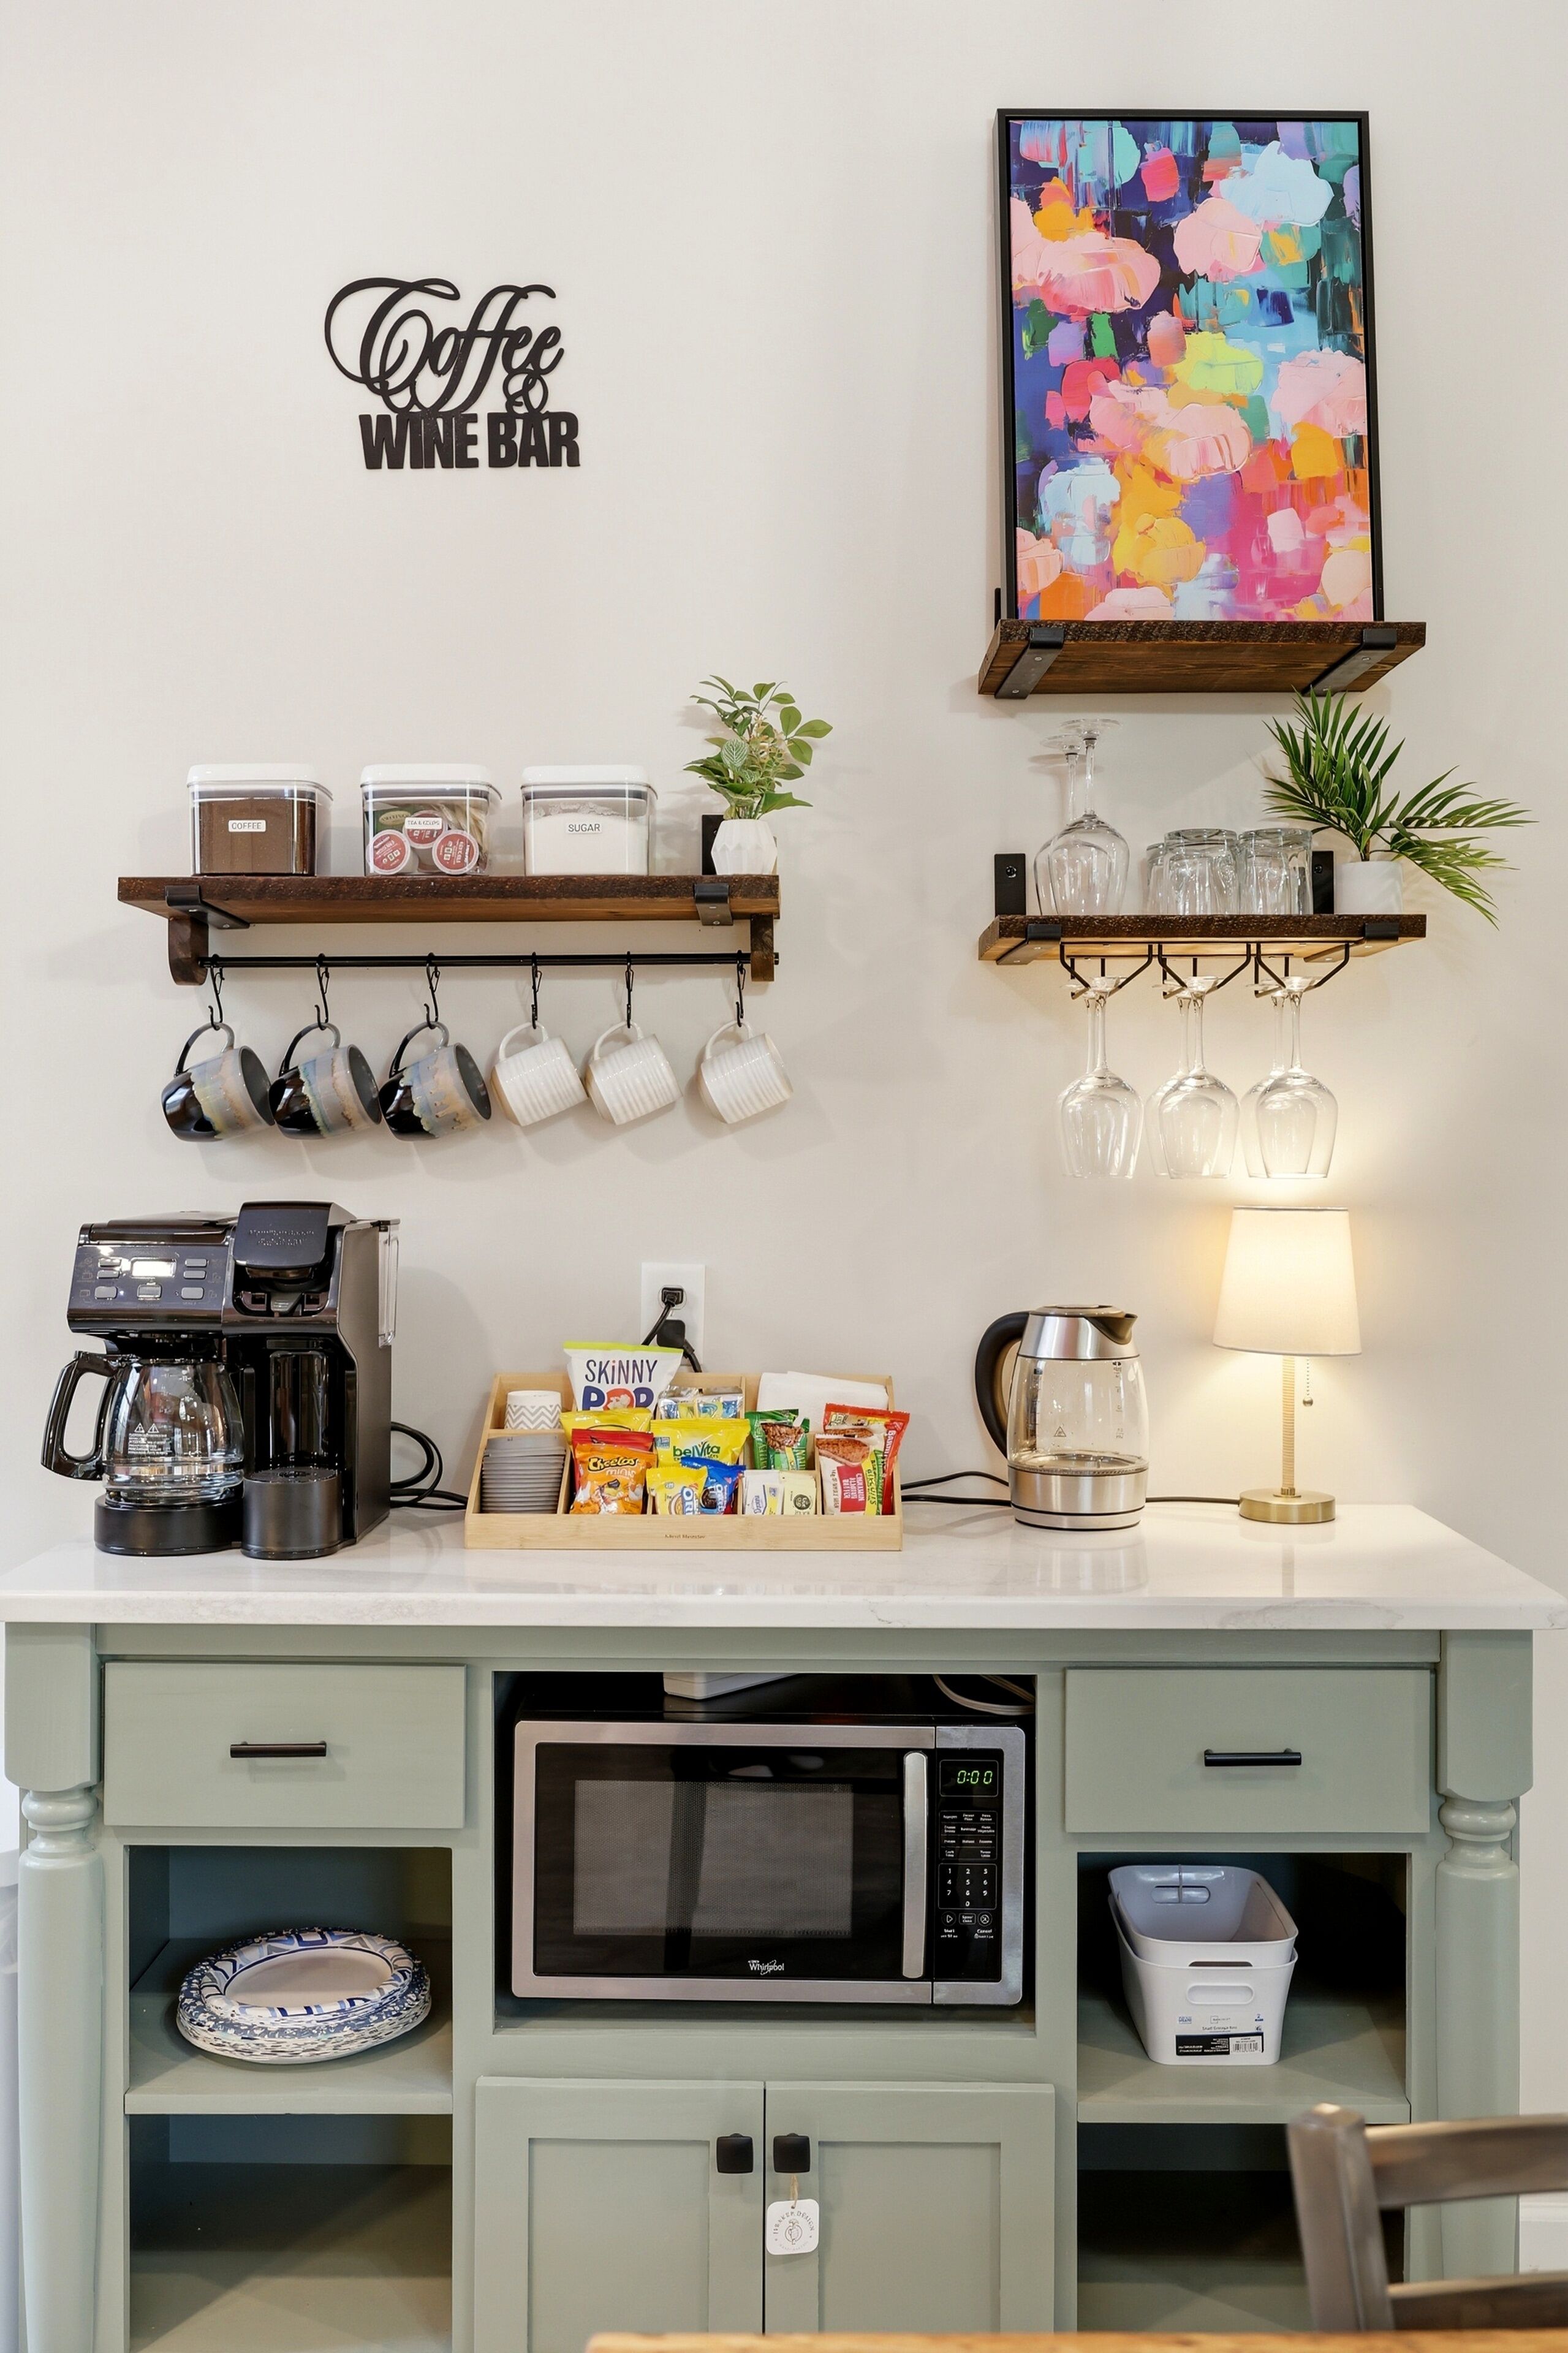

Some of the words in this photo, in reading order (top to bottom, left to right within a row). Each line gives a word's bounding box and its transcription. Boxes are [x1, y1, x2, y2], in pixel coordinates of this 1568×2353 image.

[324, 278, 564, 413] Coffee
[502, 368, 548, 415] &
[358, 413, 479, 470] WINE
[487, 411, 580, 468] BAR
[568, 823, 600, 832] SUGAR
[582, 1385, 654, 1412] POP
[673, 1441, 721, 1457] belVita
[588, 1457, 640, 1472] Cheetos
[957, 1770, 993, 1784] 0:00
[748, 1960, 784, 1975] Whirlpool
